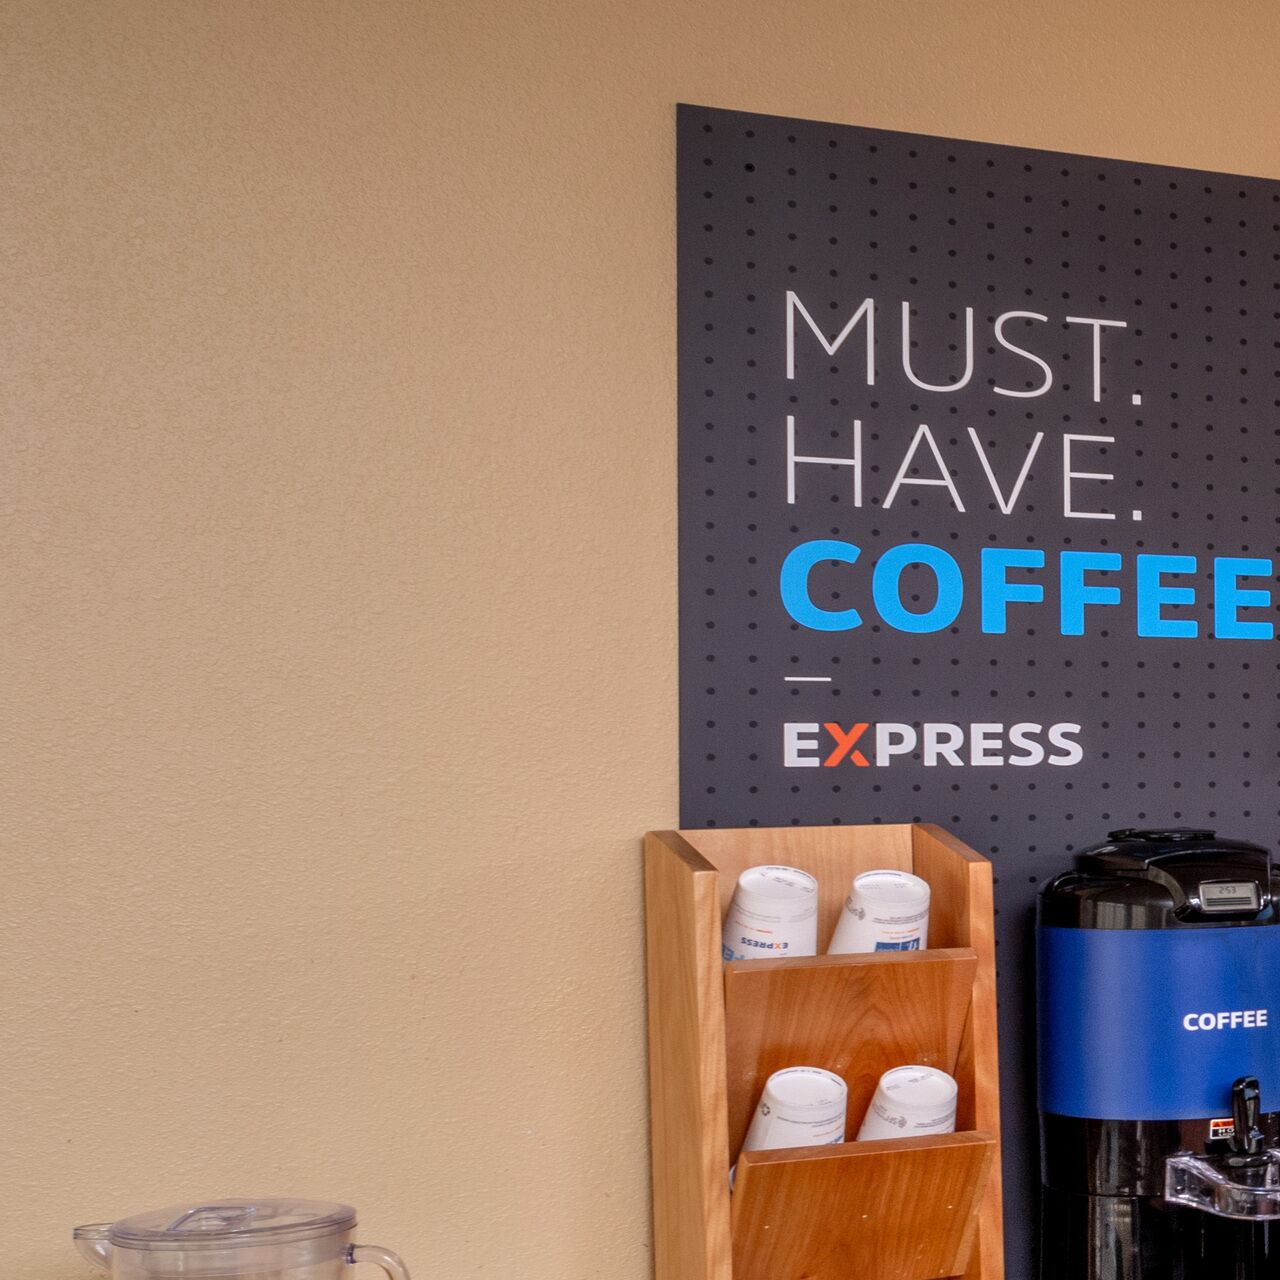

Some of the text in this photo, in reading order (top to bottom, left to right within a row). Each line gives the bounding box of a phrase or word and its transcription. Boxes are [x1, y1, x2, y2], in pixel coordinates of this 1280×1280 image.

[786, 290, 1142, 405] MUST.
[785, 415, 1142, 521] HAVE.
[783, 722, 1084, 767] EXPRESS
[741, 937, 788, 949] EXPRESS
[1183, 1009, 1268, 1031] COFFEE
